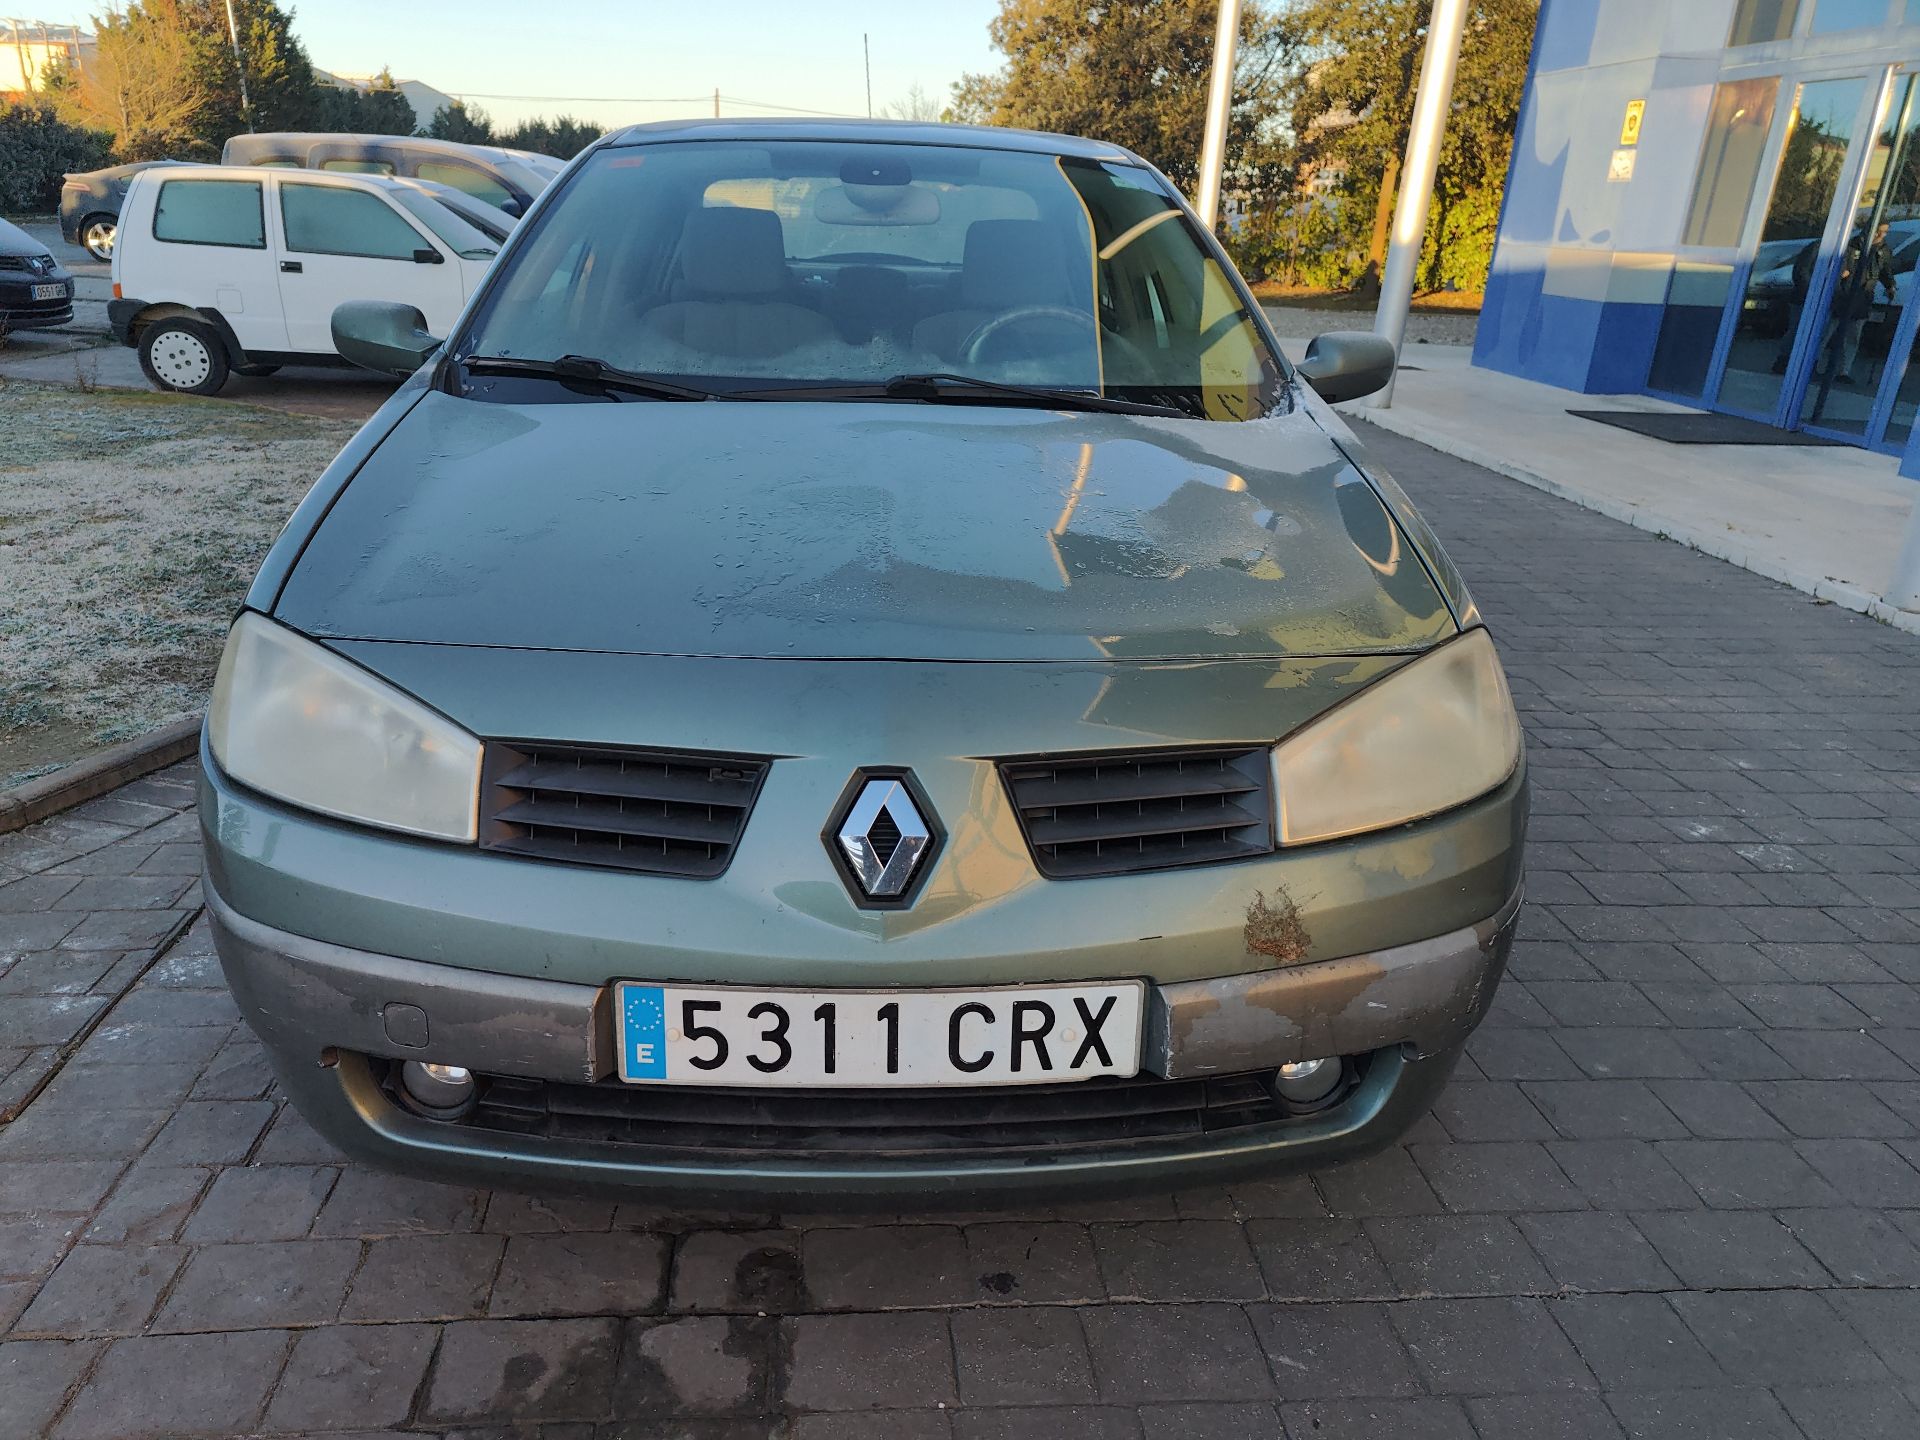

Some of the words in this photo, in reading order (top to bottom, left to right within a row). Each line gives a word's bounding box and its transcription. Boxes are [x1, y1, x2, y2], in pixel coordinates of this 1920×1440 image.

[636, 1043, 655, 1064] E
[682, 999, 900, 1074] 5311
[948, 996, 1118, 1073] CRX
